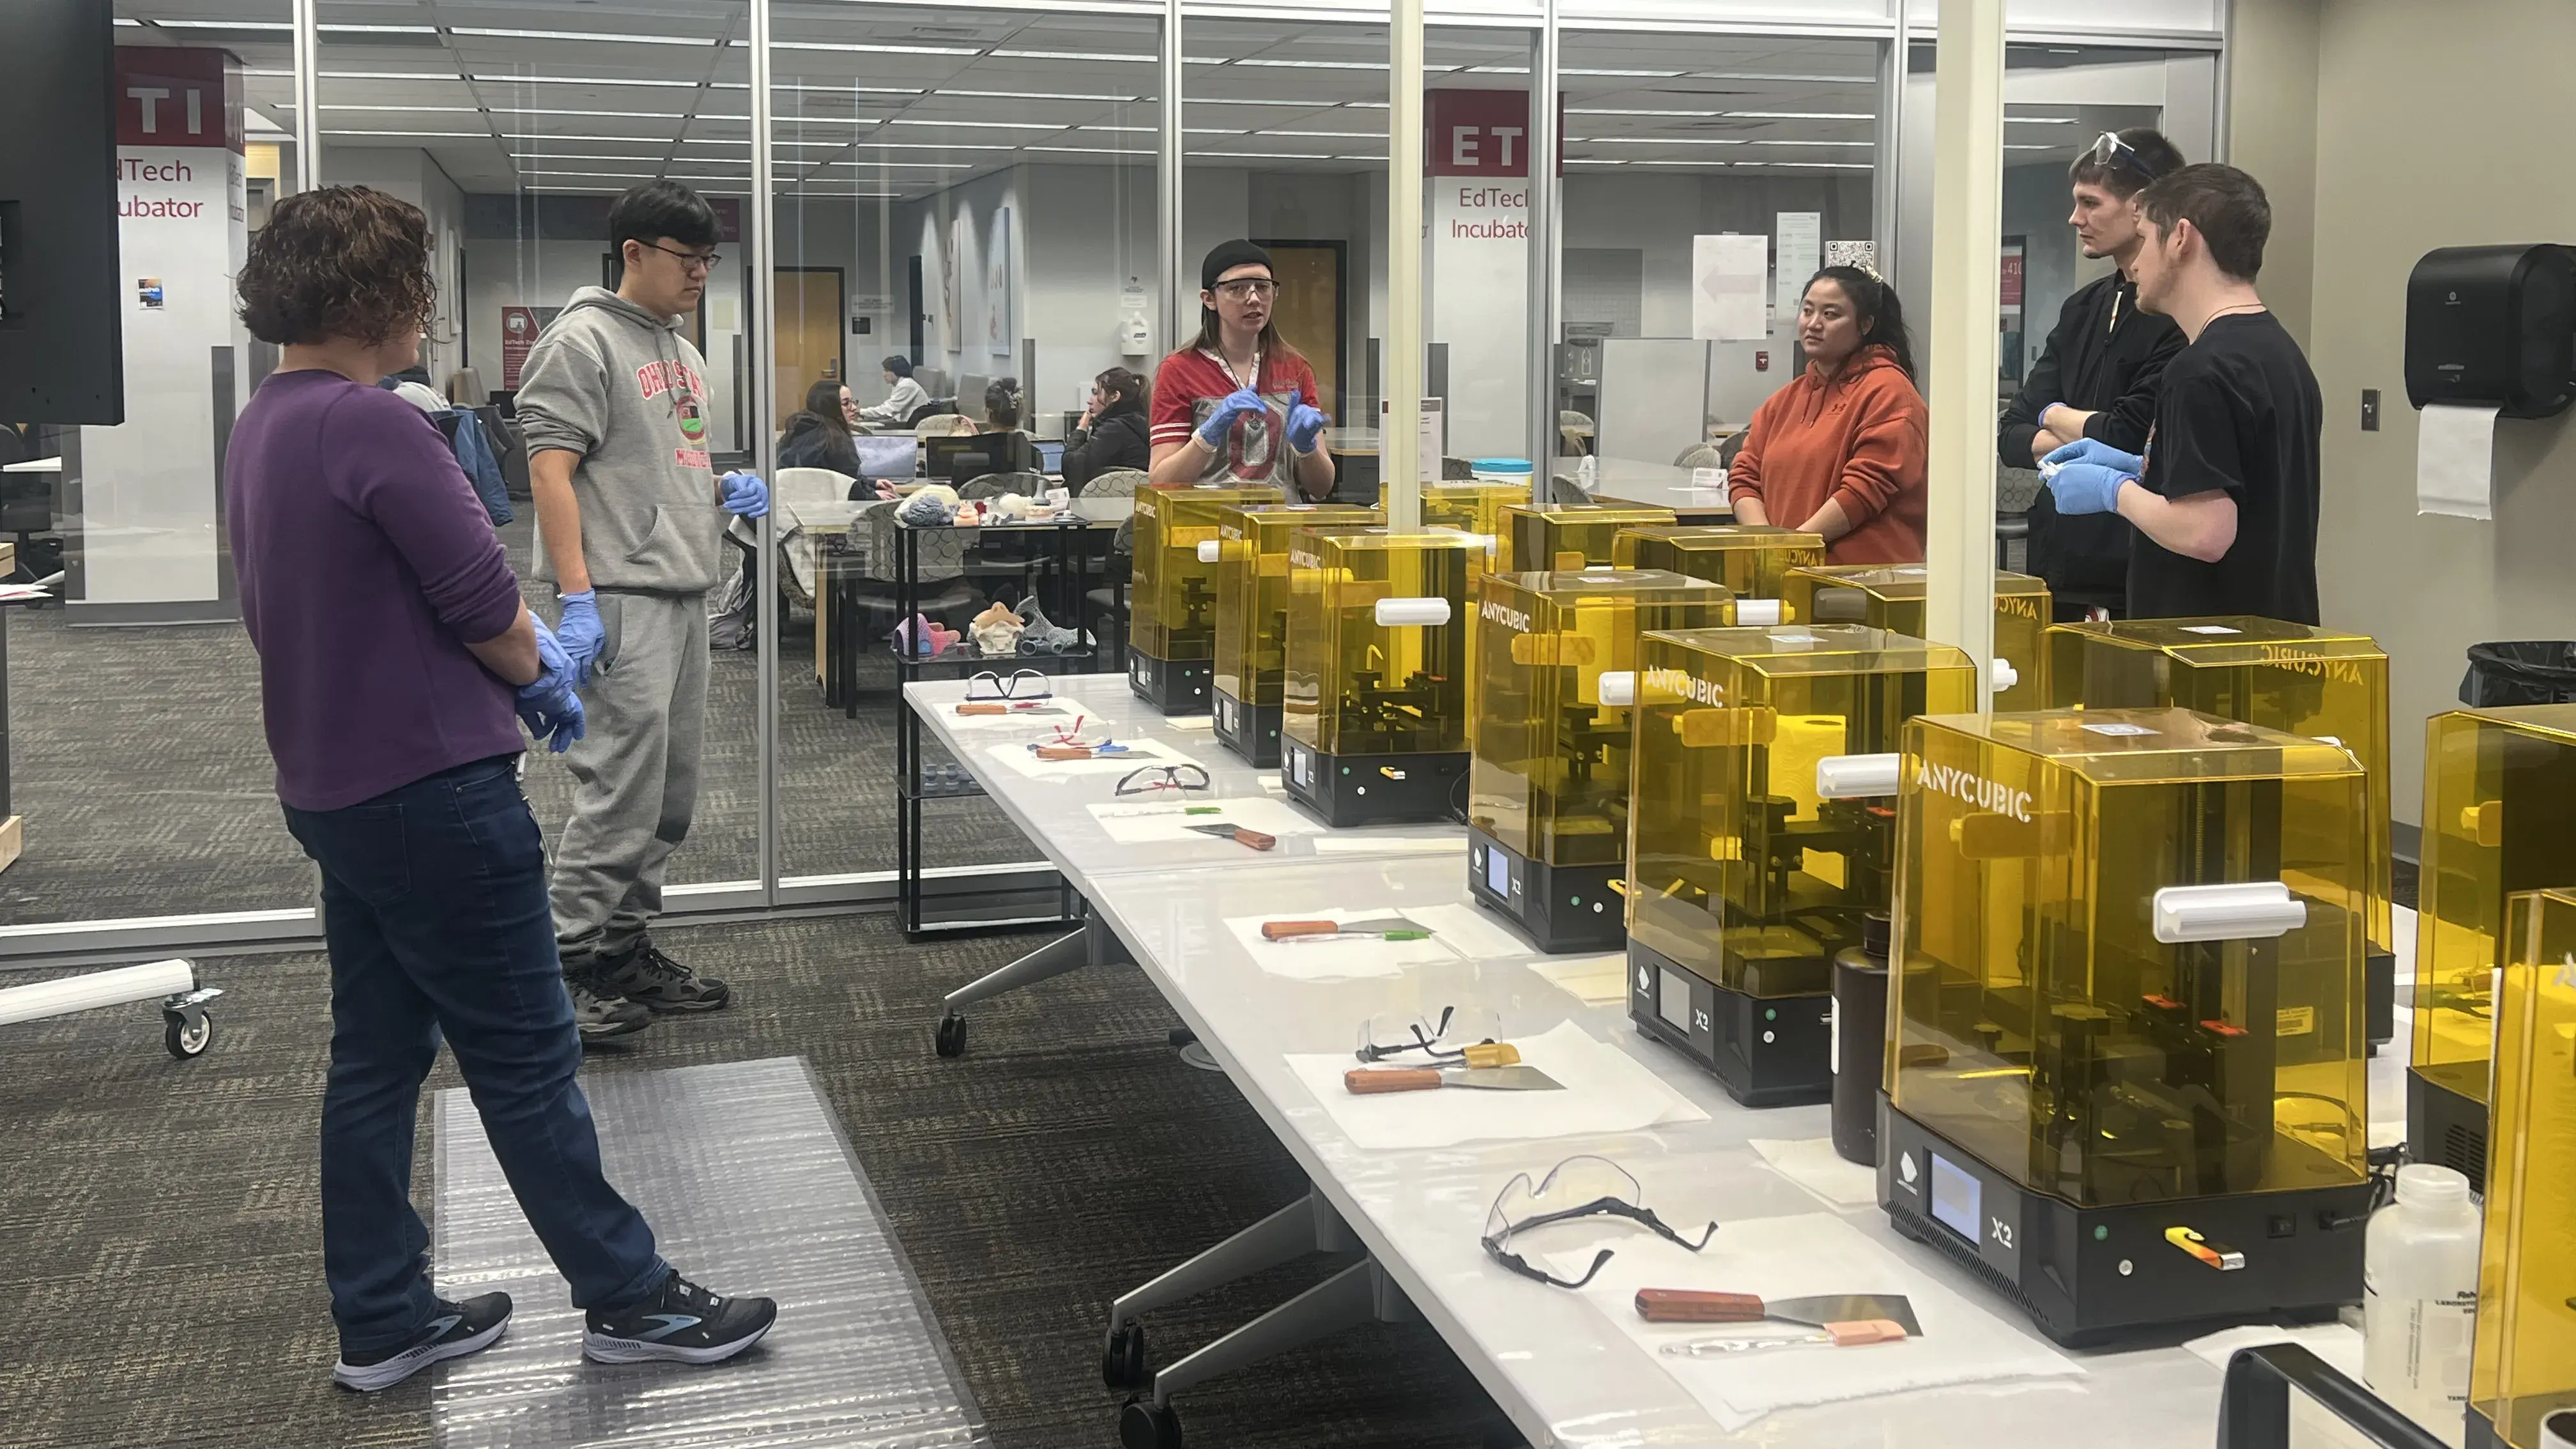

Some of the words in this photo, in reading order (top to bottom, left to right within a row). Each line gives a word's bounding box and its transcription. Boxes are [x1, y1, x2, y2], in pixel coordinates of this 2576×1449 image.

[126, 88, 202, 135] TI
[1452, 126, 1522, 166] ET
[117, 158, 192, 181] Tech
[118, 195, 204, 217] ubator
[1452, 219, 1528, 238] Incubat
[1291, 548, 1321, 571] ANYCUBIC
[1481, 599, 1530, 633] ANYCUBIC
[1646, 664, 1724, 709] ANYCUBIC
[1917, 758, 2033, 824] ANYCUBIC
[1511, 877, 1522, 896] X2
[1695, 1008, 1710, 1032] X2
[1991, 1216, 2013, 1249] X2
